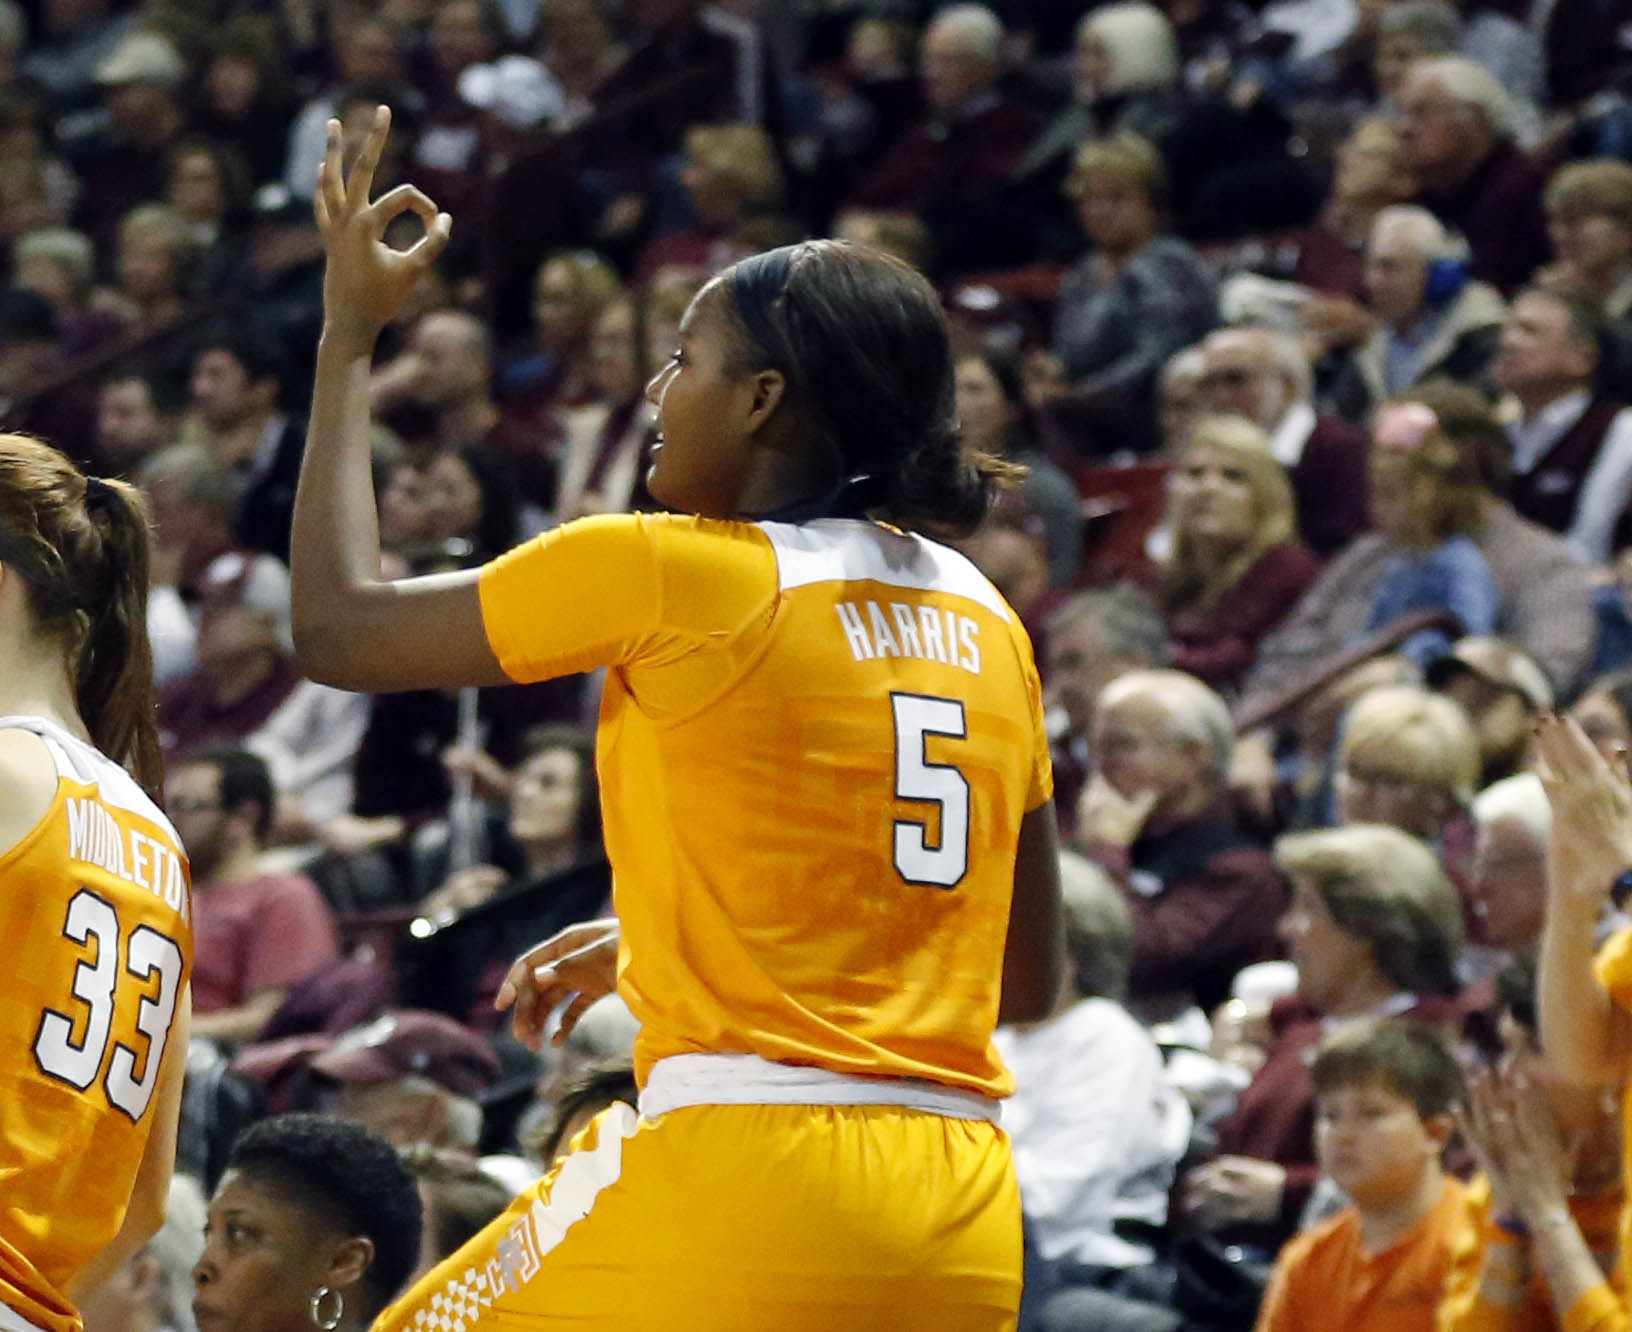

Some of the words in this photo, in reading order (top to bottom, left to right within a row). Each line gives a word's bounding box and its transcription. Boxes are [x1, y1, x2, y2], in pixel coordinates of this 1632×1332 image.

[835, 600, 981, 675] HARRIS
[65, 797, 188, 928] MIDDLETO
[889, 690, 970, 889] 5
[30, 887, 184, 1124] 33
